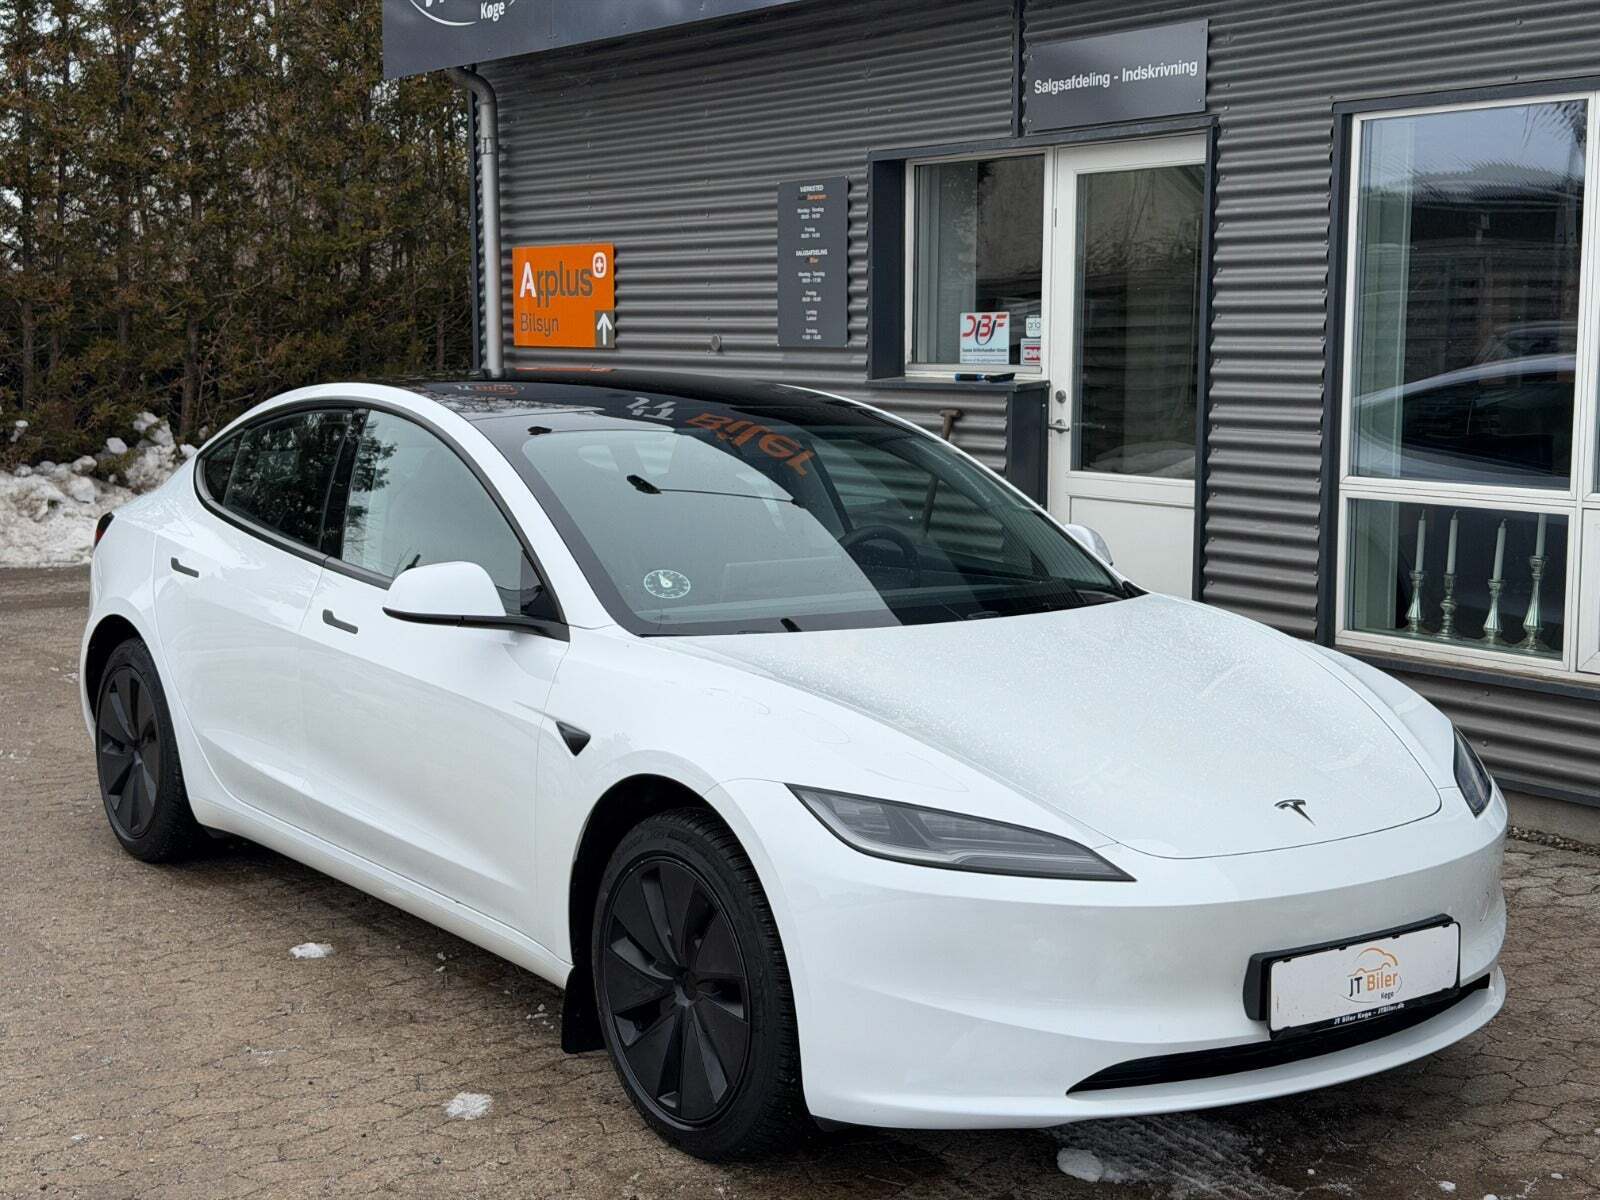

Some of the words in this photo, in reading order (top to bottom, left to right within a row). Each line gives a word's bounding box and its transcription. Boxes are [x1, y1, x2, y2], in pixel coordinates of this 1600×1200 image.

[480, 2, 505, 21] Køge
[1034, 73, 1110, 95] Salgsafdeling
[1122, 60, 1198, 83] Indskrivning
[520, 312, 559, 337] Bilsyn
[1349, 976, 1363, 998] JT
[1366, 971, 1398, 991] Biler
